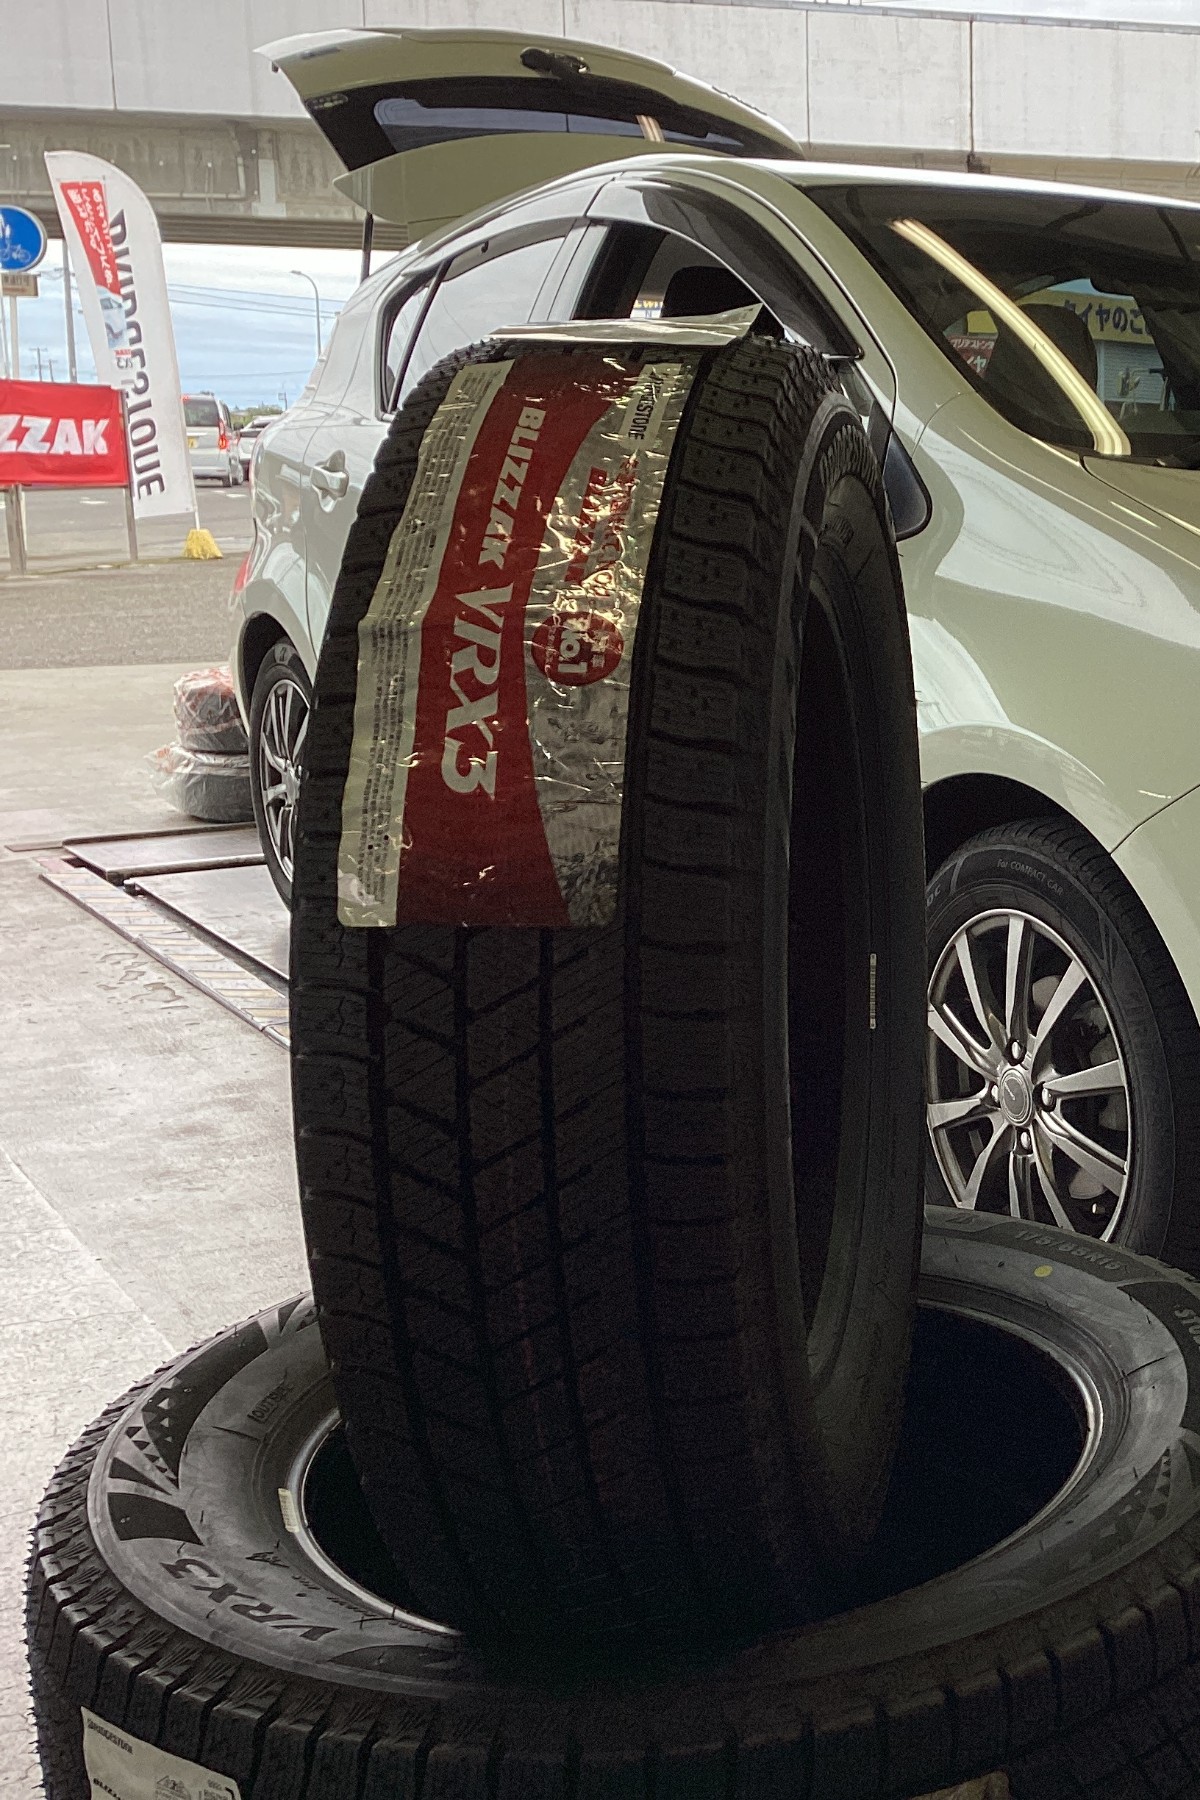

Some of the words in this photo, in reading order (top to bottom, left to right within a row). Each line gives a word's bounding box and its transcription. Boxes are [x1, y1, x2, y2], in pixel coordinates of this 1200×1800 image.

[476, 406, 547, 573] BLIZZAK
[440, 583, 515, 800] VRX3
[1010, 861, 1047, 883] COMPACT
[1047, 880, 1064, 896] CAR
[161, 1557, 341, 1641] VRX3
